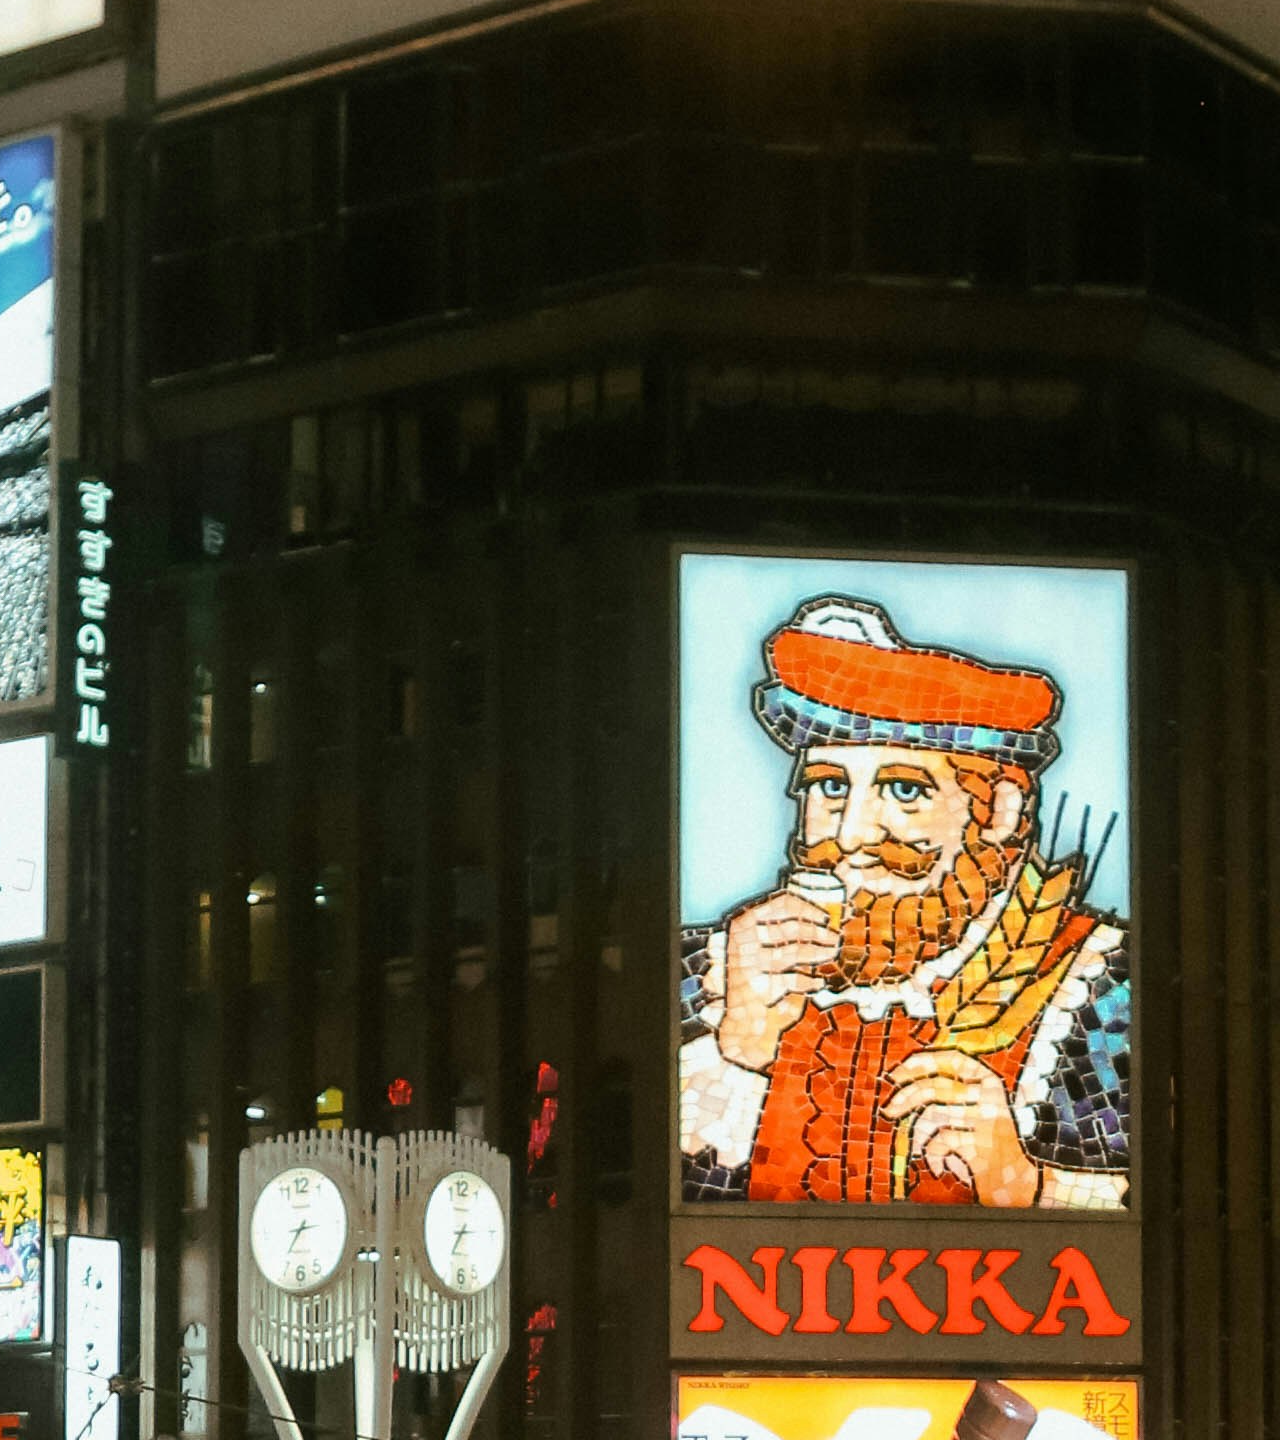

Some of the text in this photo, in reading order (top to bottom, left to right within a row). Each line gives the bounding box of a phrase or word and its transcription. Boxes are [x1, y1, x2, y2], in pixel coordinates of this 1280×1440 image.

[77, 479, 113, 750] すすきのビル
[294, 1177, 308, 1193] 12
[456, 1181, 468, 1197] 12
[296, 1265, 306, 1281] 6
[457, 1269, 465, 1284] 6
[683, 1245, 1130, 1336] NIKKA
